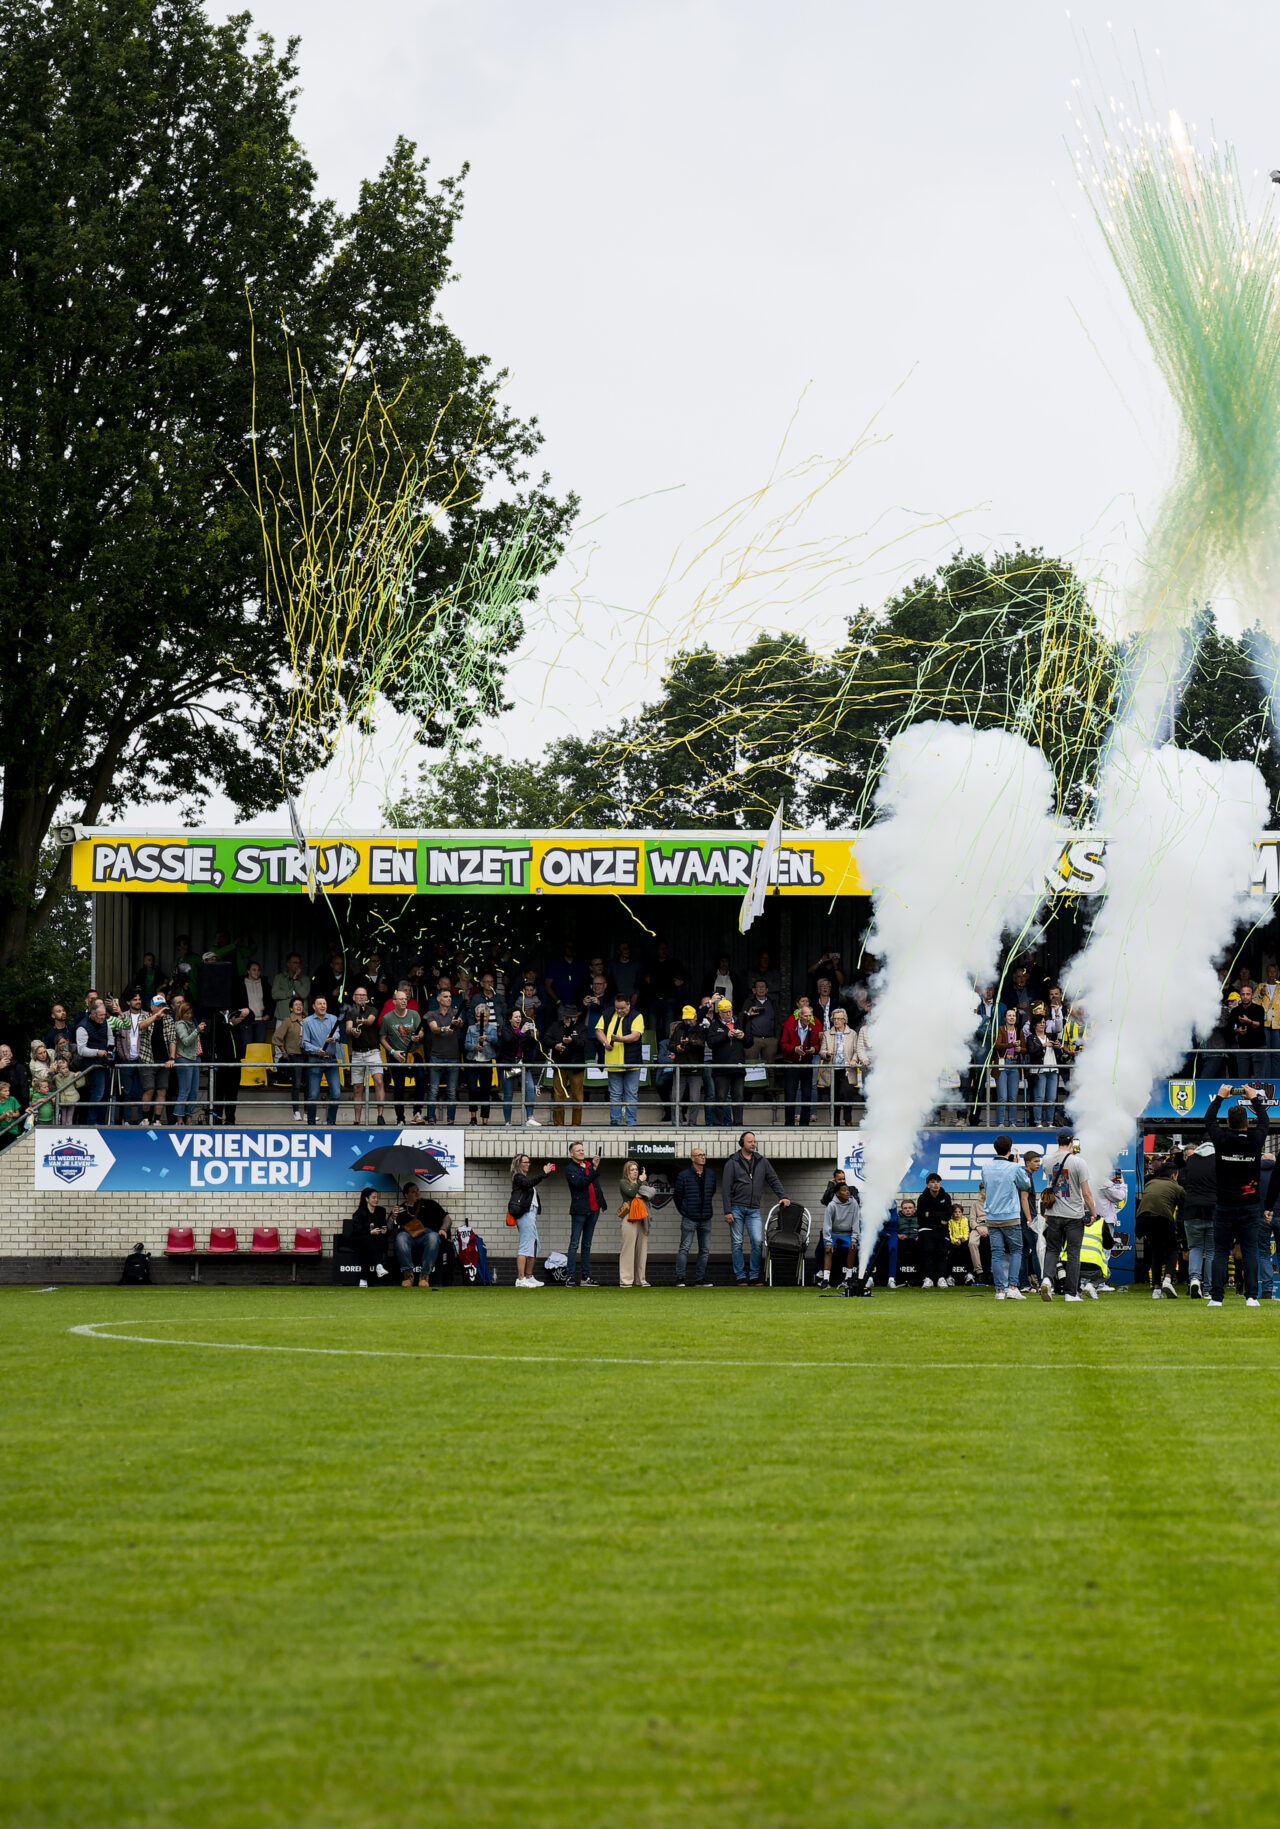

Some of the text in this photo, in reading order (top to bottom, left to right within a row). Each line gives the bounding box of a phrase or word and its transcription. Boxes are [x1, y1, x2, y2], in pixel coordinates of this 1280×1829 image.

[92, 843, 225, 888] PASSIE,
[369, 846, 418, 885] EN
[426, 846, 533, 886] INZET
[540, 847, 639, 886] ONZE
[169, 1133, 332, 1158] VRIENDEN
[636, 1144, 644, 1153] FC
[644, 1145, 652, 1153] De
[653, 1144, 675, 1153] Rebellen
[190, 1160, 311, 1187] LOTERIJ
